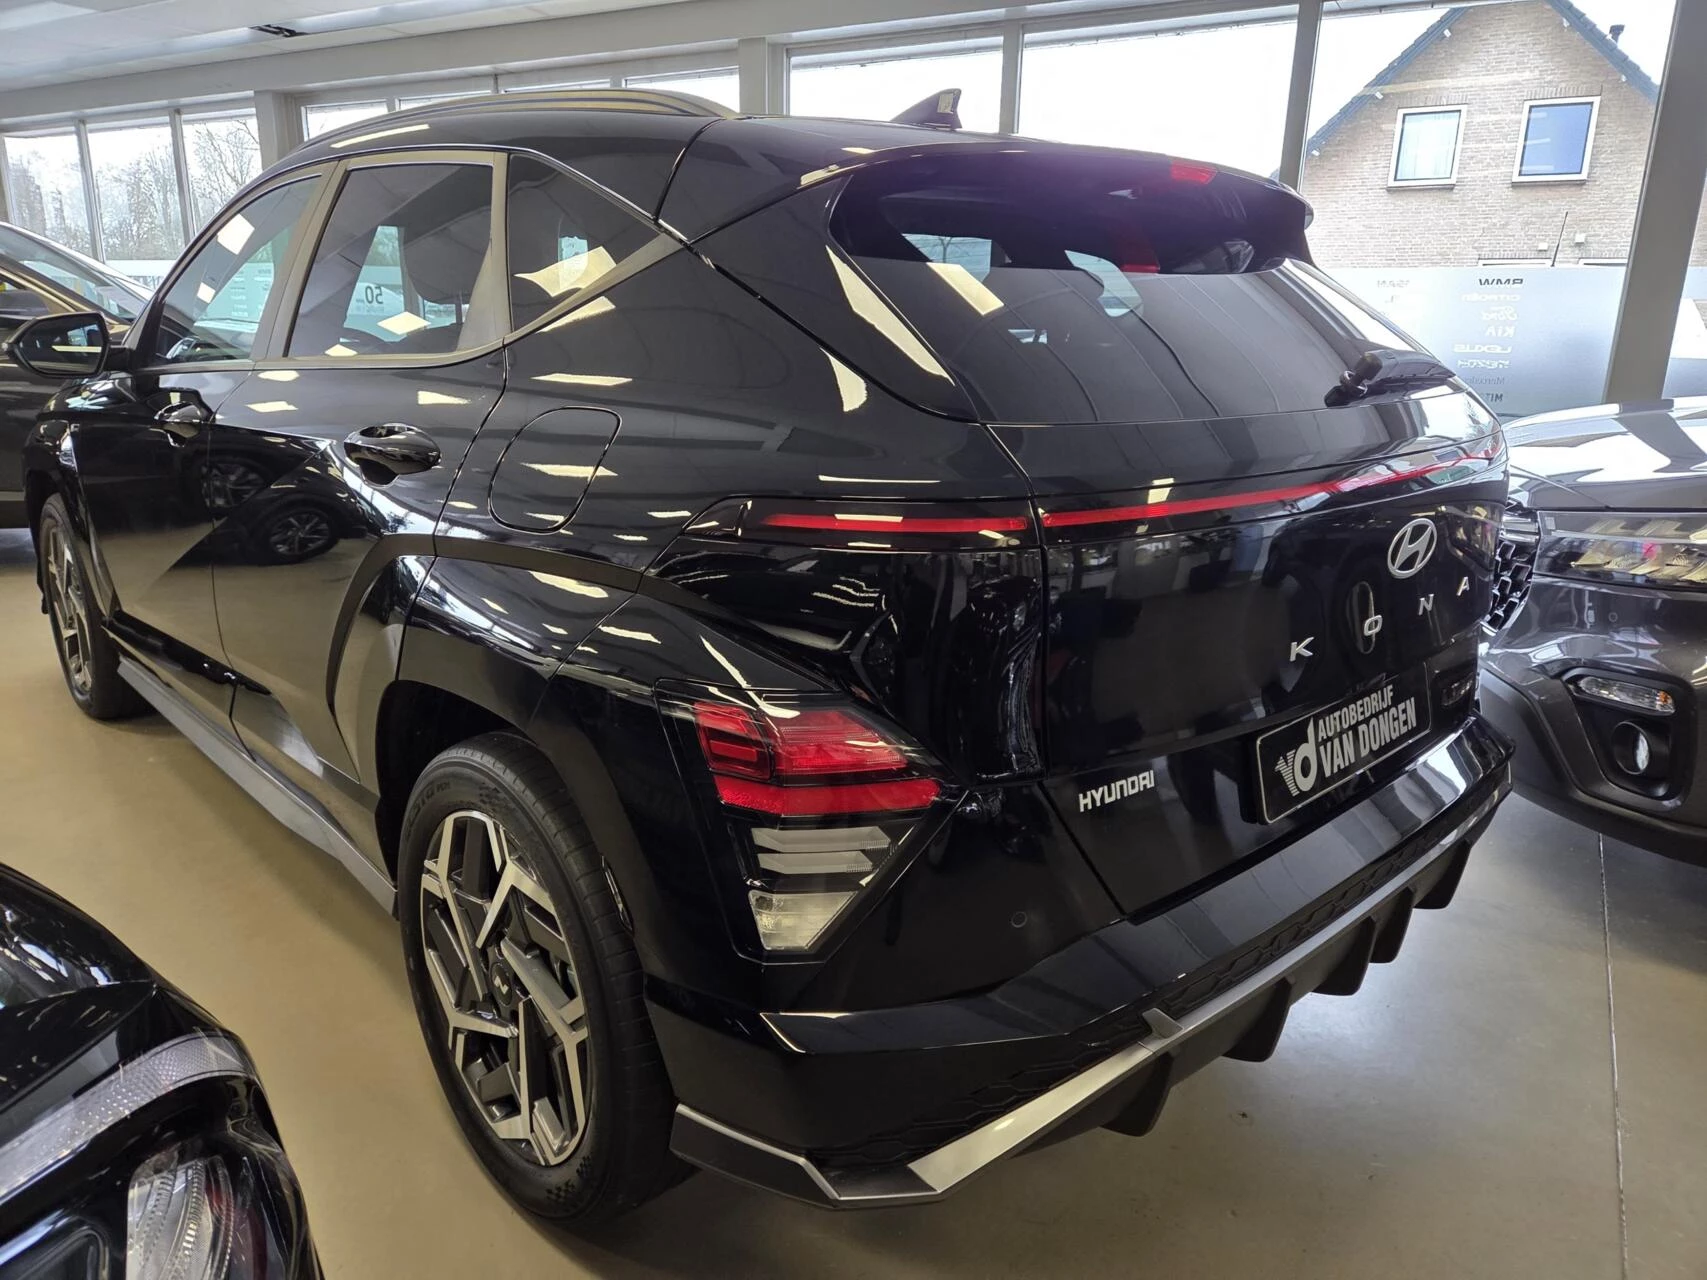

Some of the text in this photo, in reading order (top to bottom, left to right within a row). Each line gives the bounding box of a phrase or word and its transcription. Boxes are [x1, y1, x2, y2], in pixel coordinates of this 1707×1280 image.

[1317, 684, 1394, 742] AUTOBEDRIJF
[1319, 697, 1417, 778] VAN DONGEN
[1079, 770, 1155, 813] HYUNDAI
